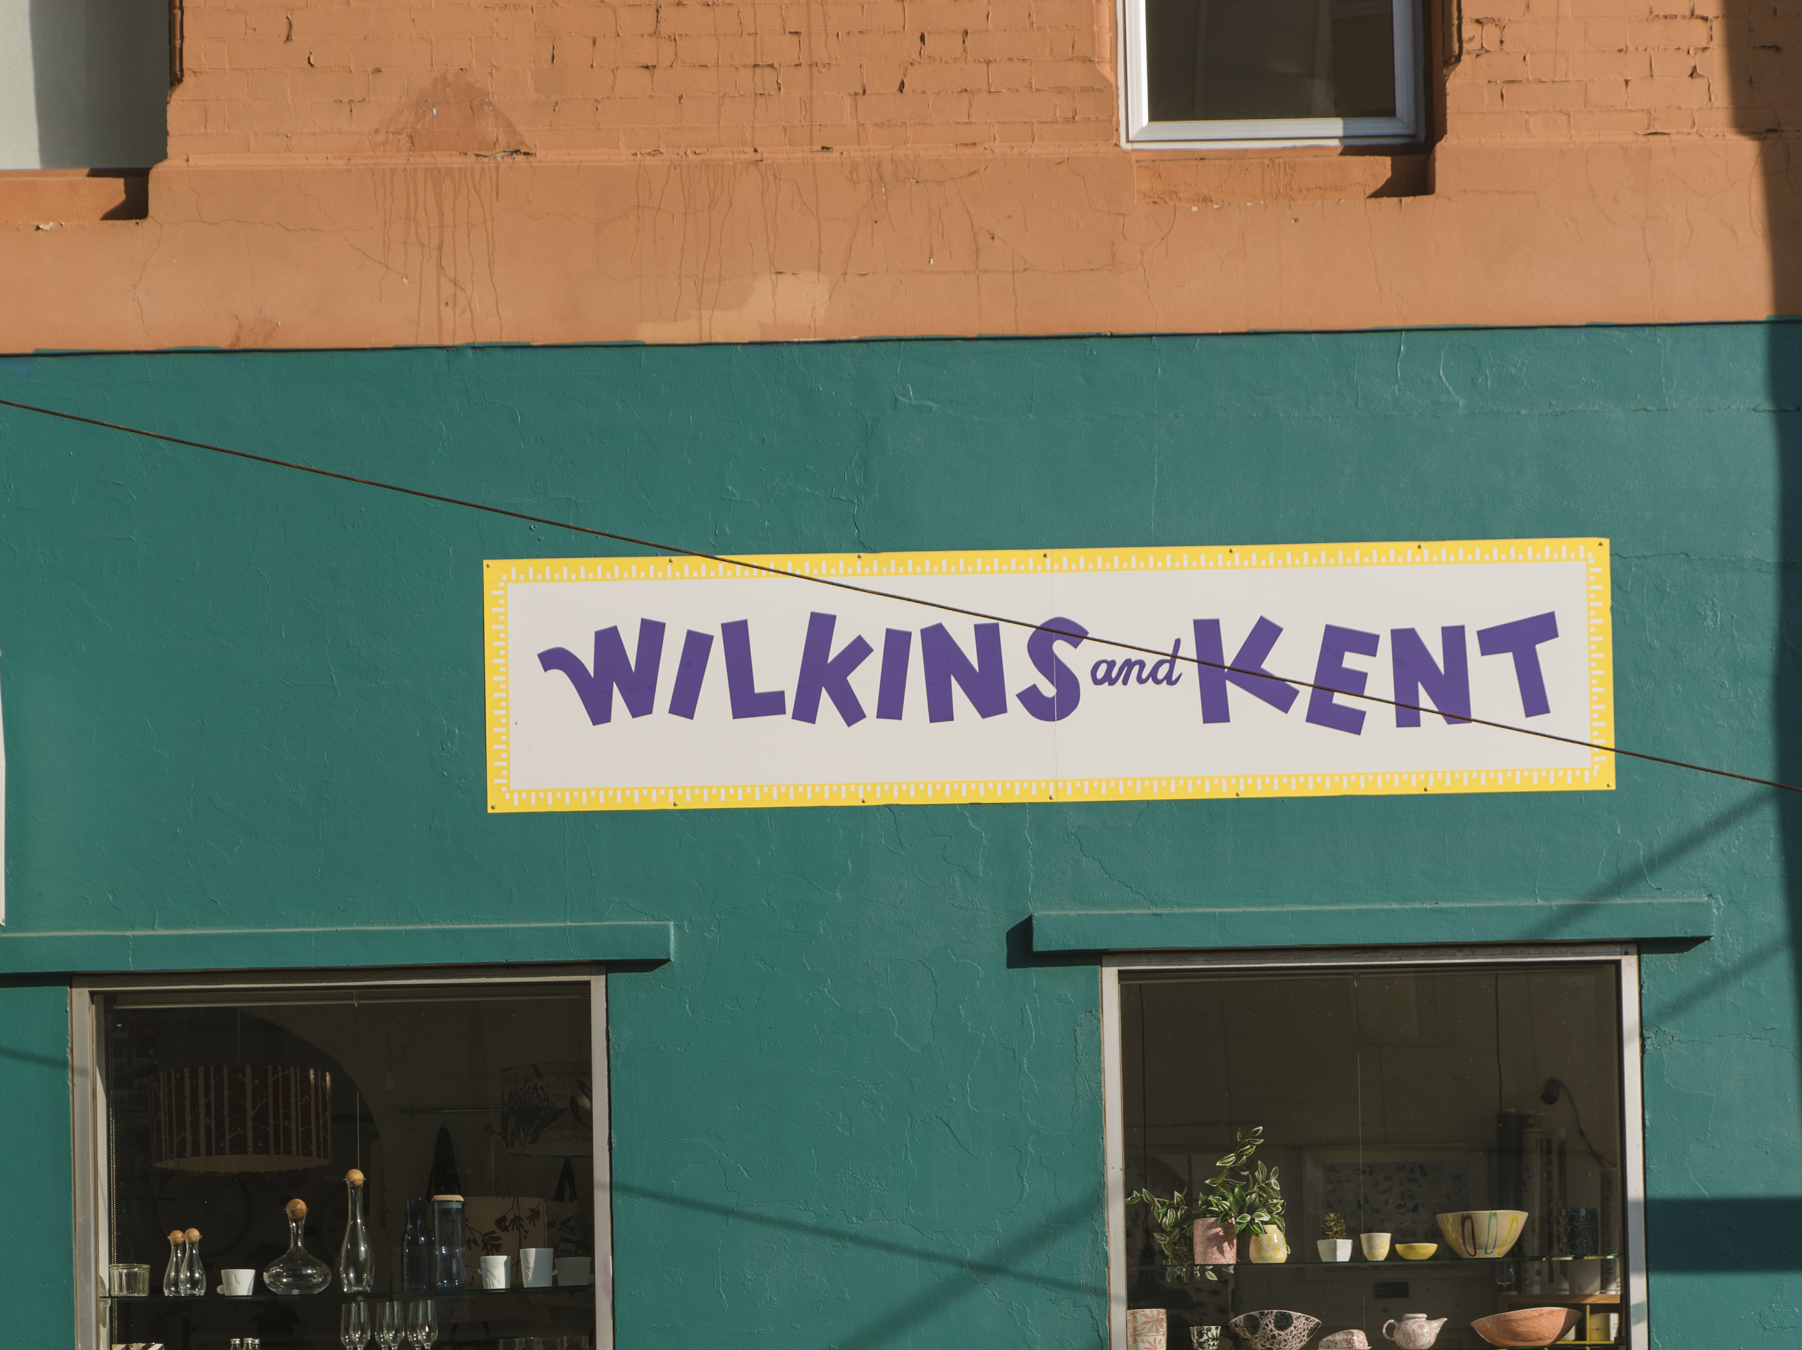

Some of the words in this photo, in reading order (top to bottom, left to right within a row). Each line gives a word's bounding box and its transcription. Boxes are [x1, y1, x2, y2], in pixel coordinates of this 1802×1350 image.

[538, 611, 1089, 727] WILKINS
[1090, 638, 1182, 686] and
[1194, 611, 1559, 736] KENT
